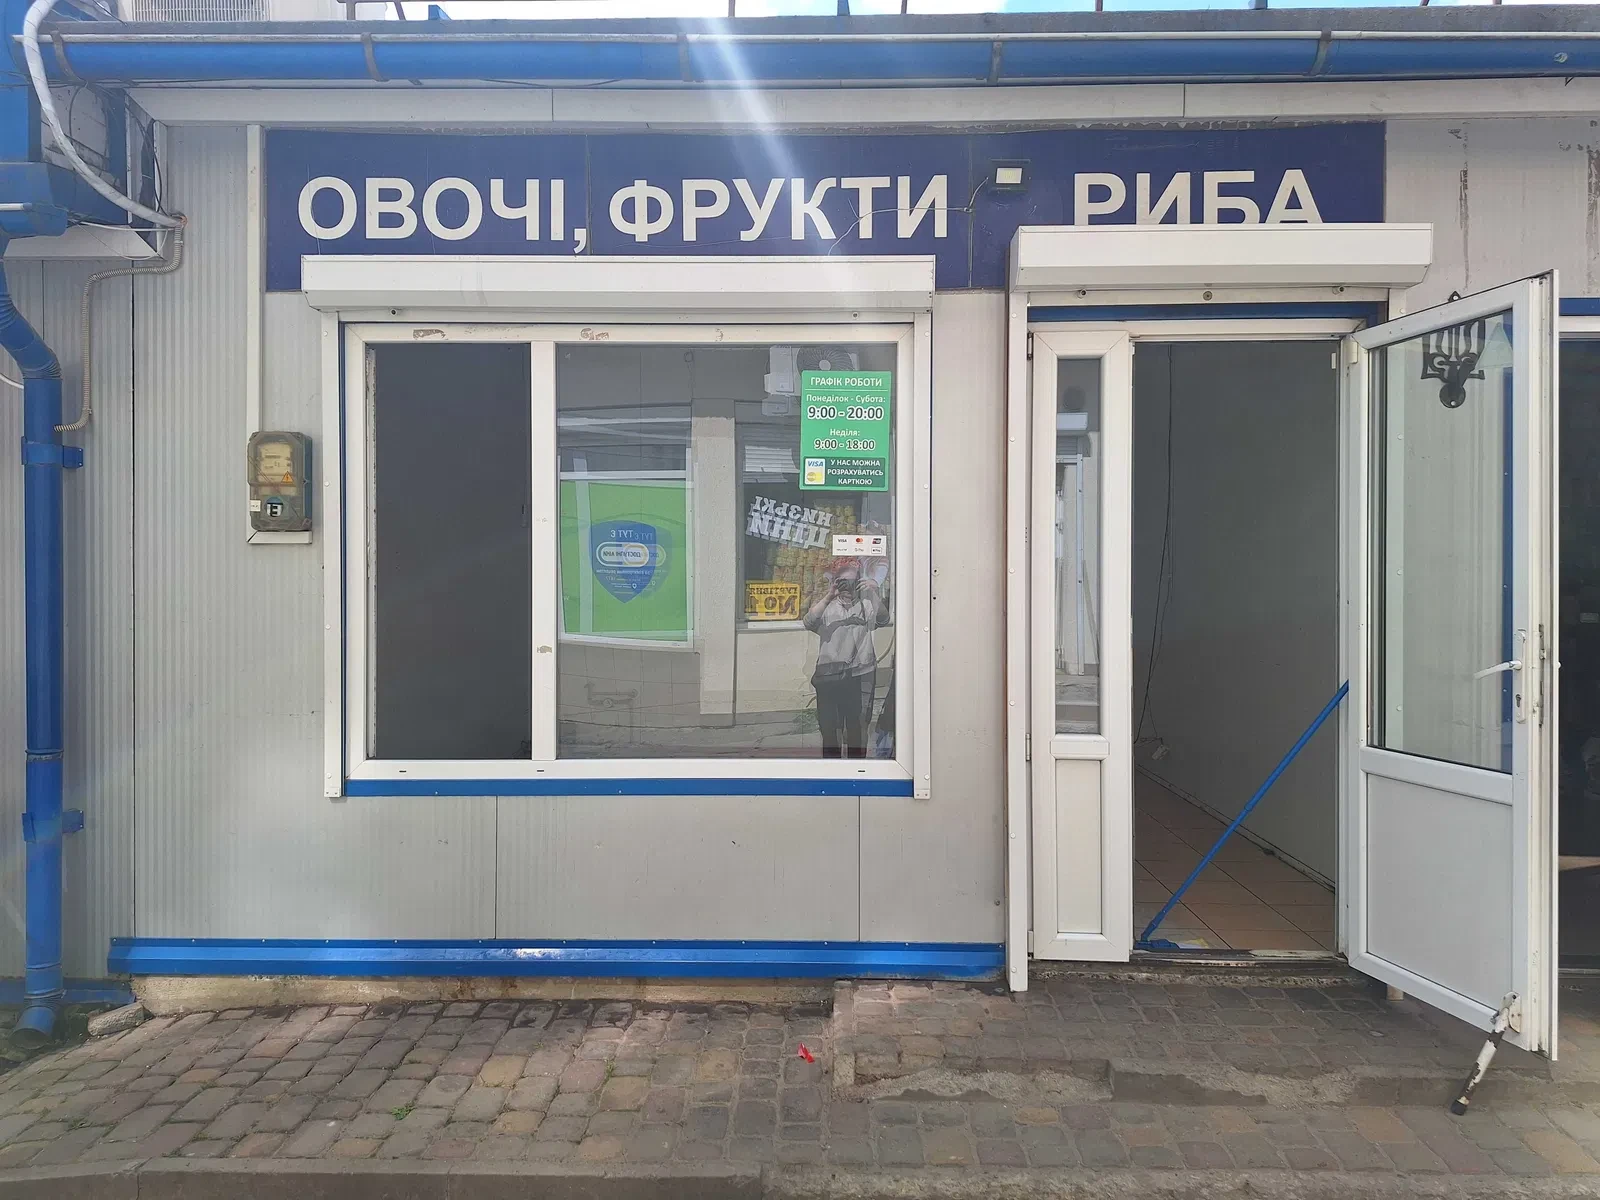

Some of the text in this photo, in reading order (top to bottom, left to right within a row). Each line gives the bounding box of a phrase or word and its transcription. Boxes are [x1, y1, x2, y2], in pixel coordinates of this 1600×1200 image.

[1074, 169, 1324, 225] РИБА
[298, 175, 948, 254] ОВОЧІ, ФРУКТИ
[810, 377, 882, 387] ГРАФІК РОБОТИ
[806, 394, 849, 403] Понеділок
[855, 395, 886, 404] Субота:
[807, 406, 836, 419] 9:00
[846, 406, 884, 420] 20:00
[829, 428, 860, 437] Неділя:
[814, 439, 837, 449] 9:00
[846, 440, 876, 450] 18:00
[852, 459, 880, 467] МОЖНА
